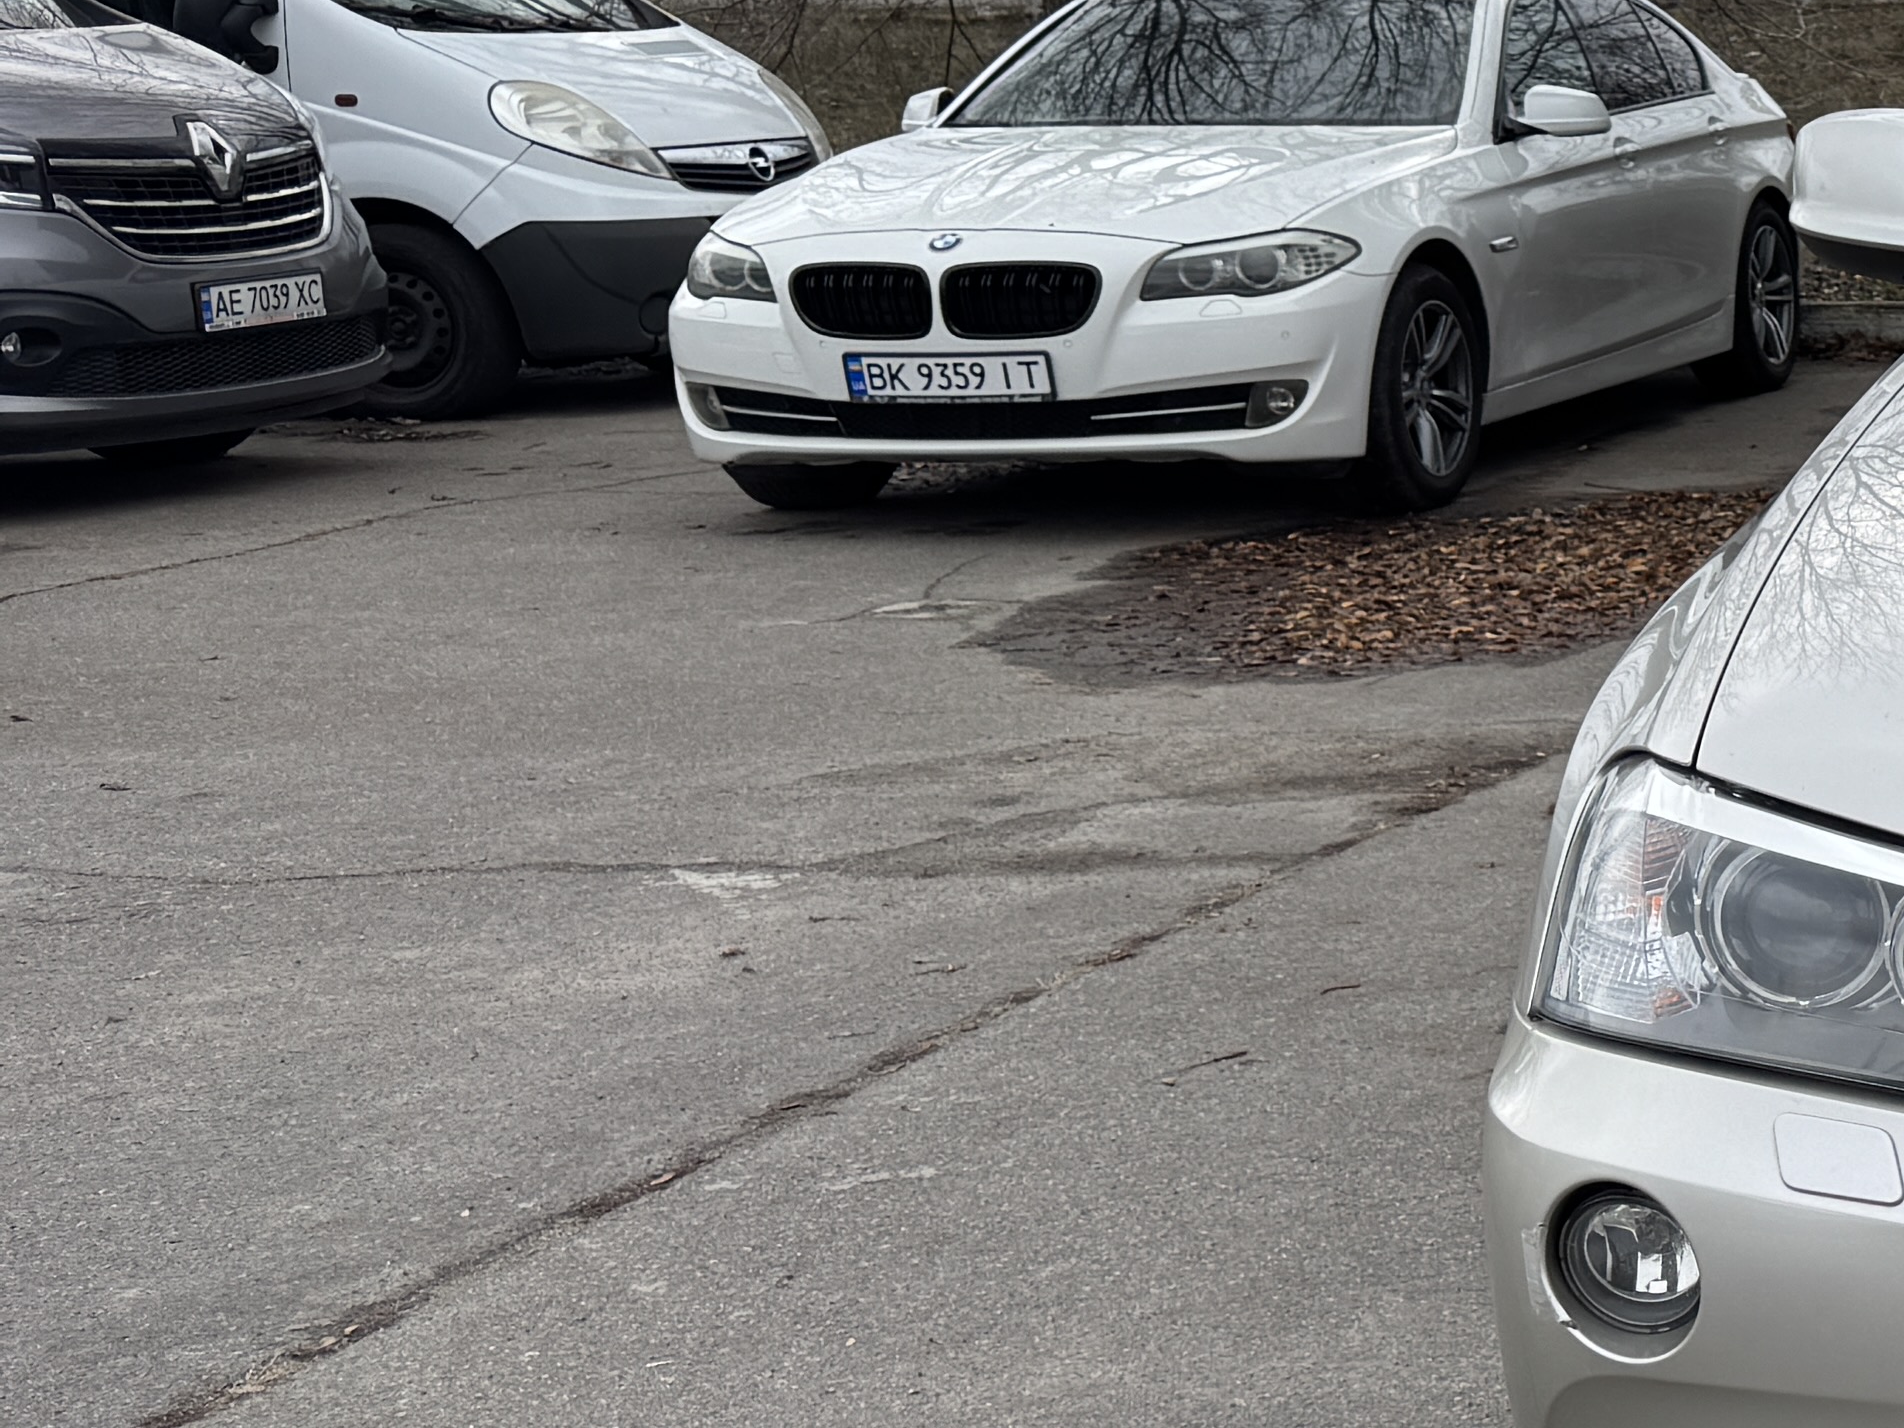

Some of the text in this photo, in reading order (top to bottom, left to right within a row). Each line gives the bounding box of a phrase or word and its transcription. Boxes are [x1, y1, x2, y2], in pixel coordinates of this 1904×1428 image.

[216, 280, 320, 318] AE 7039 XC
[866, 362, 911, 391] BK
[917, 362, 985, 390] 9359
